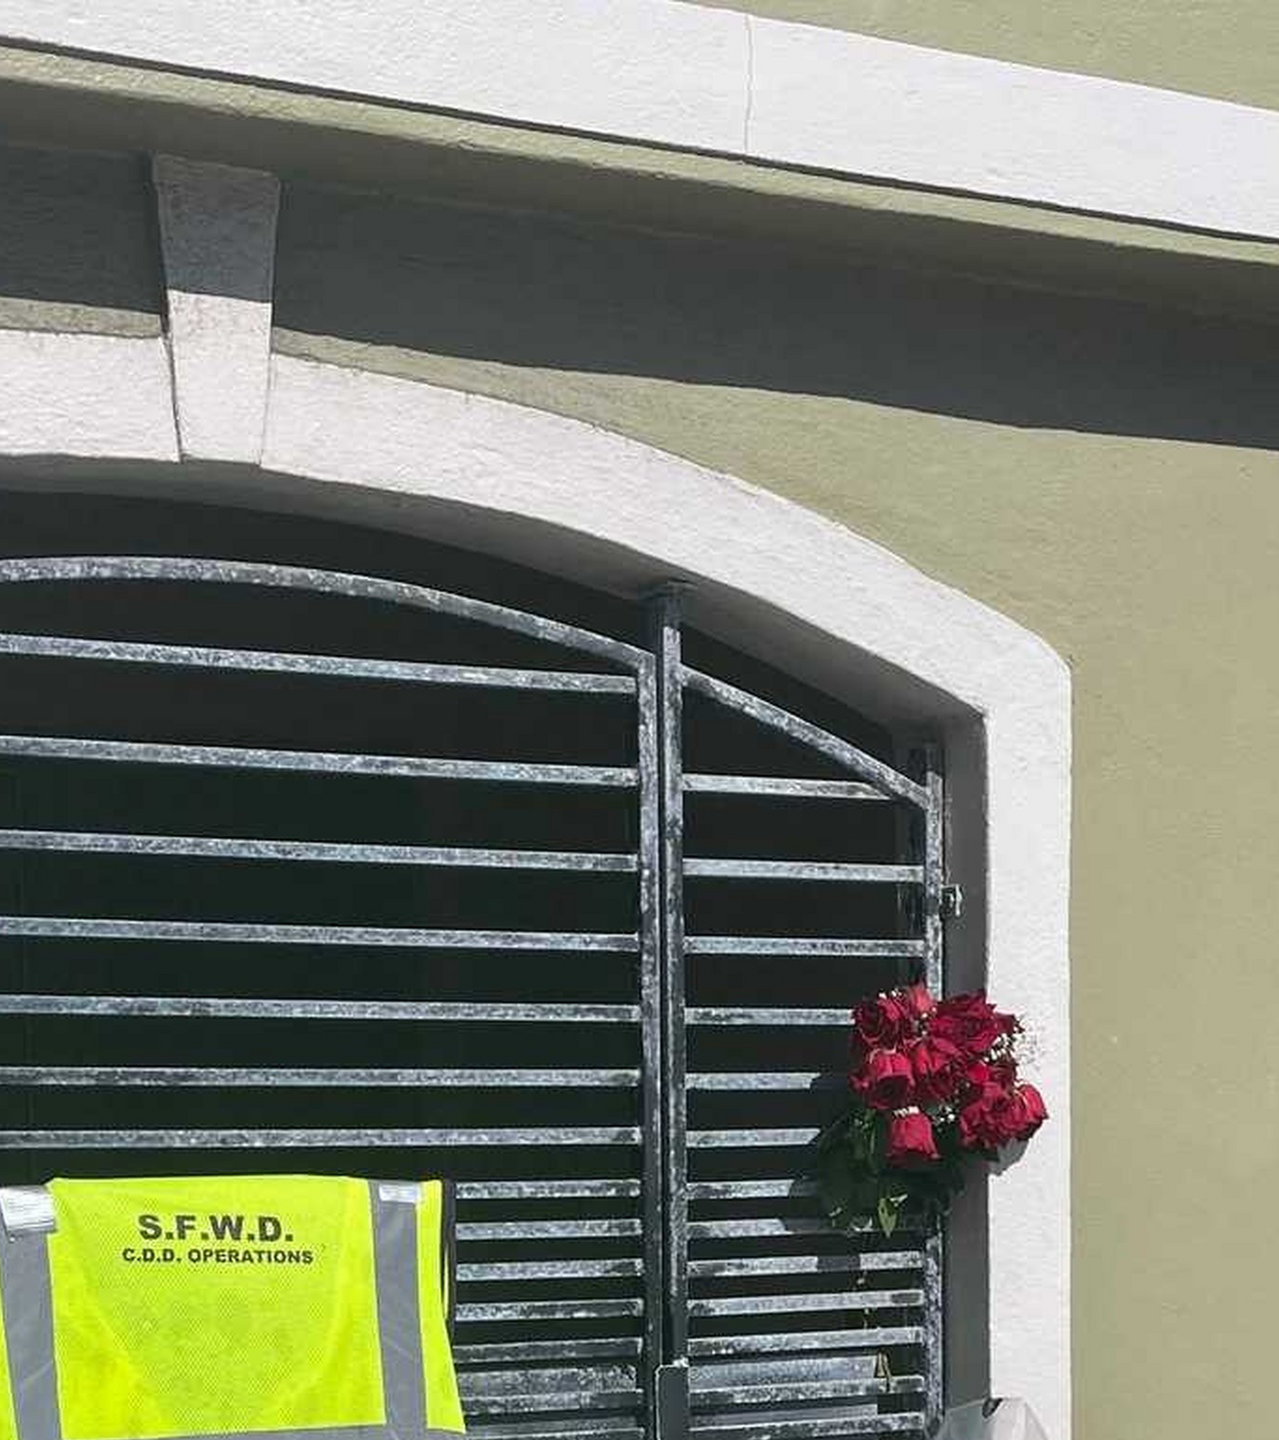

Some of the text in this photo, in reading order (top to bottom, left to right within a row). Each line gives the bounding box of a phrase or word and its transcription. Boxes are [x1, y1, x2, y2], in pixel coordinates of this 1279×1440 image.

[138, 1215, 294, 1242] S.F.W.D.
[122, 1248, 314, 1264] C.D.D. OPERATIONS
